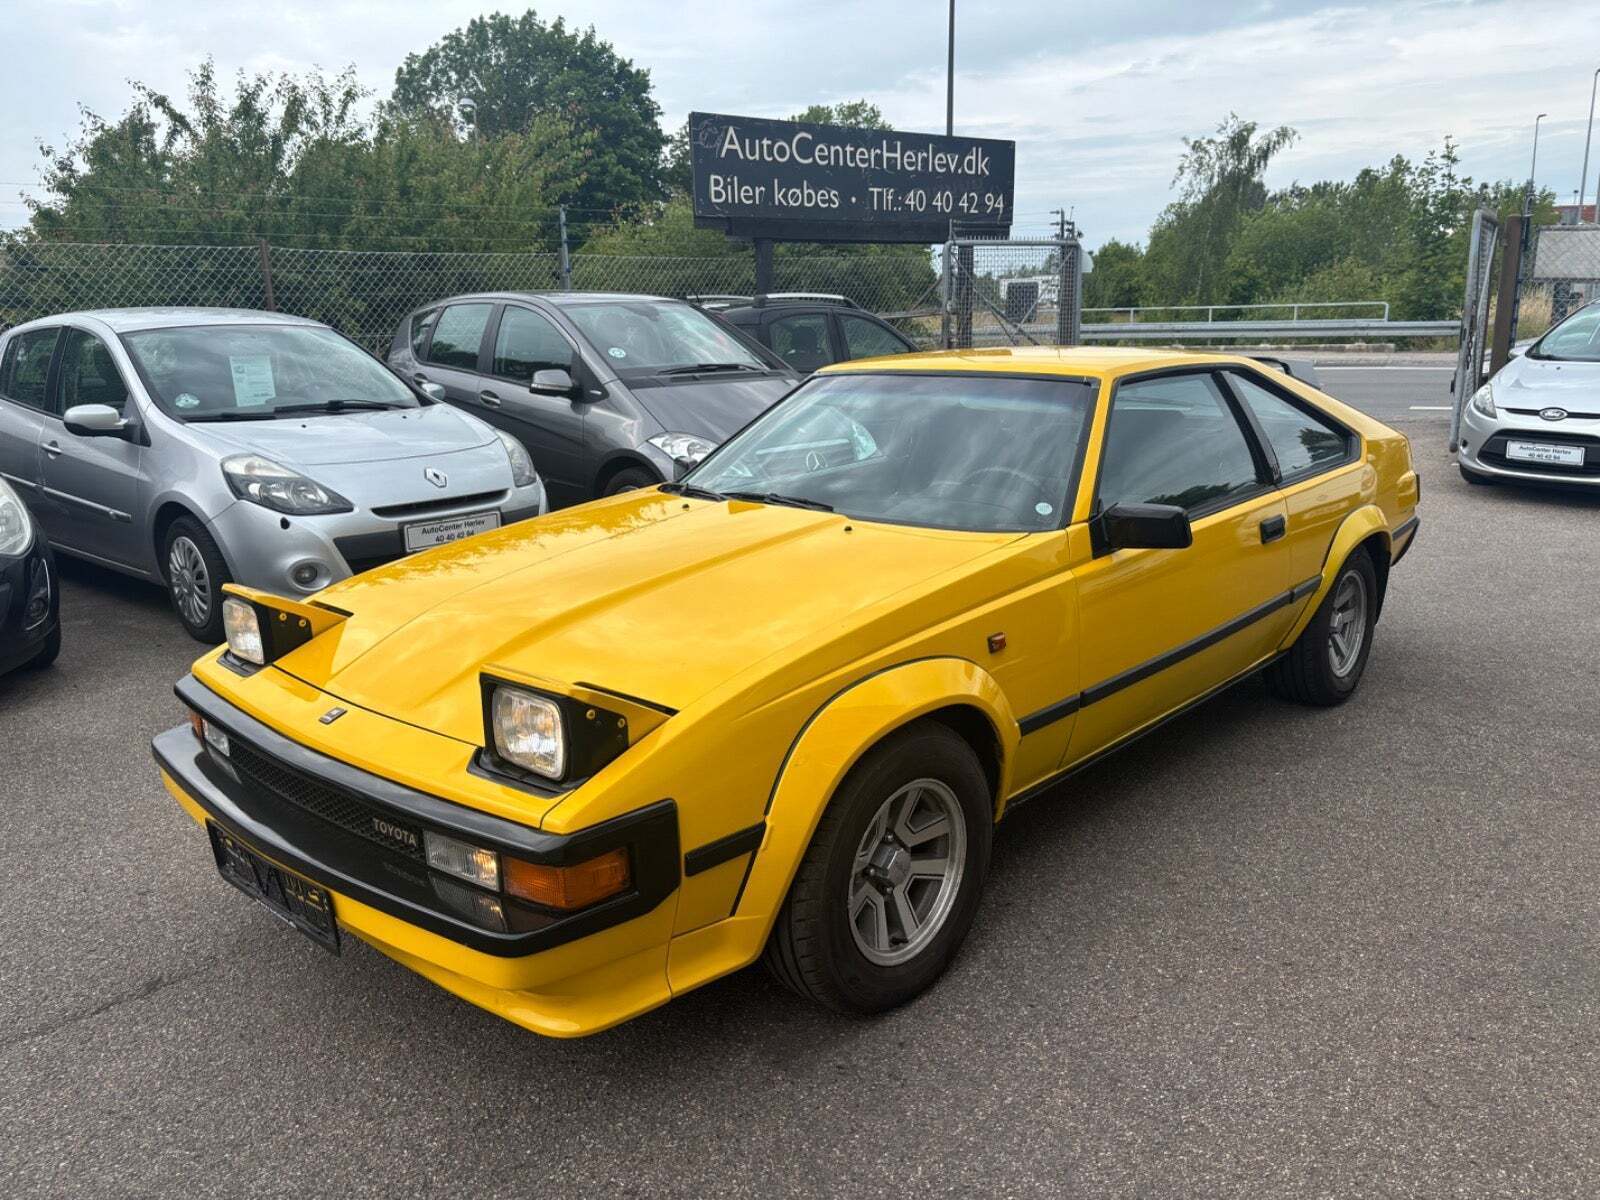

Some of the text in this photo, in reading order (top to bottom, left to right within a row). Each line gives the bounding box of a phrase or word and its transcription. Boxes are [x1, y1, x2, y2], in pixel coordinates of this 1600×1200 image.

[720, 126, 990, 176] AutoCenterHerlev.dk
[709, 174, 766, 205] Biler
[773, 178, 840, 208] købes
[932, 191, 953, 213] 40
[959, 192, 979, 214] 42
[984, 192, 1004, 214] 94
[422, 523, 462, 534] AutoCenter
[435, 534, 445, 542] 40
[446, 532, 456, 540] 40
[456, 531, 465, 539] 42
[372, 817, 417, 848] TOYOTA
